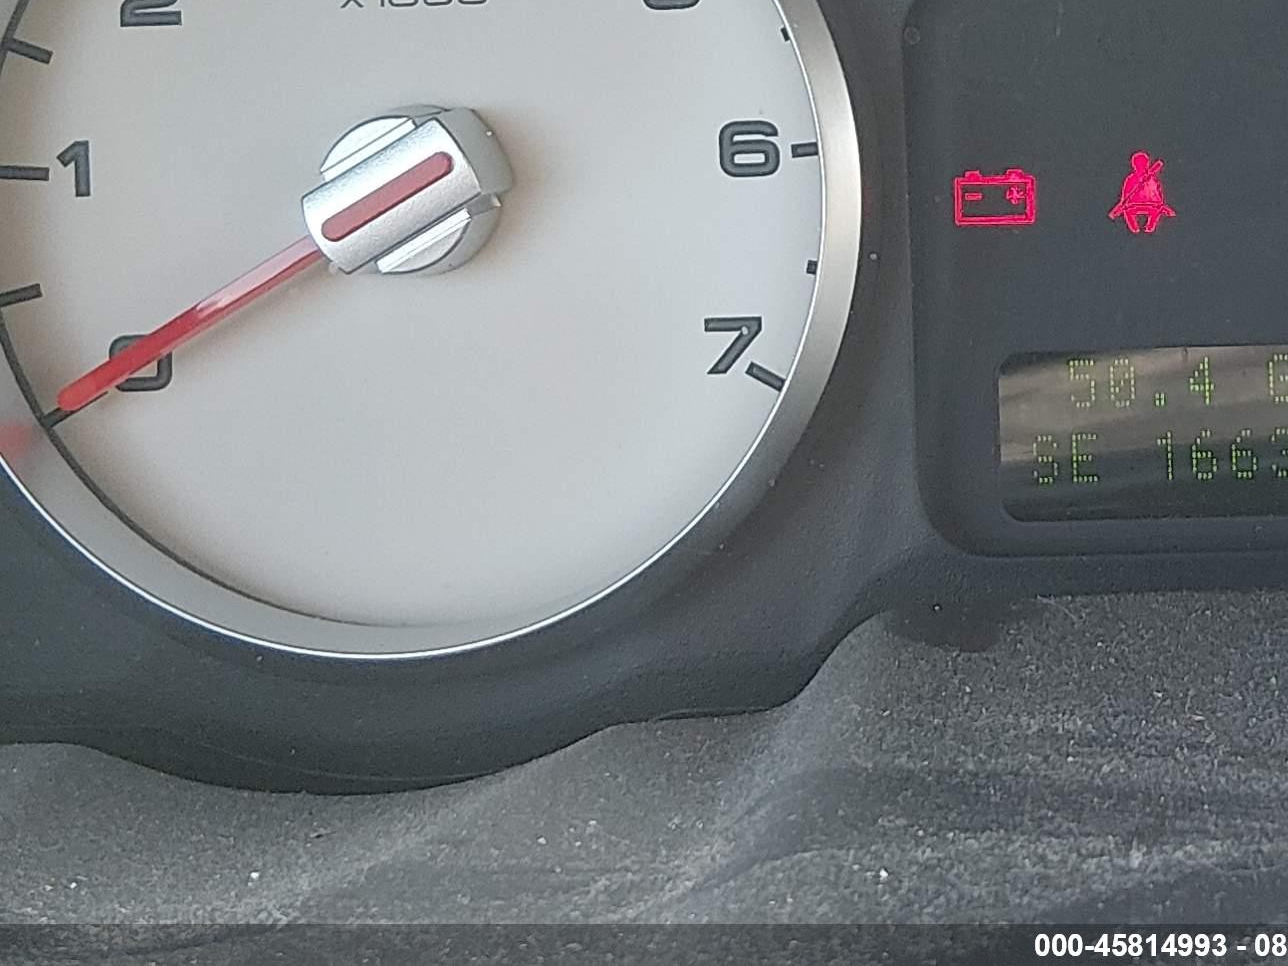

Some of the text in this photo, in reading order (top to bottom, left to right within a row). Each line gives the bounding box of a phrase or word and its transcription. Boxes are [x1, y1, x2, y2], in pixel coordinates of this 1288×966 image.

[56, 140, 92, 198] 1
[718, 120, 781, 177] 6
[703, 316, 763, 375] 7
[1068, 355, 1215, 409] 50.4
[1033, 434, 1101, 485] SE
